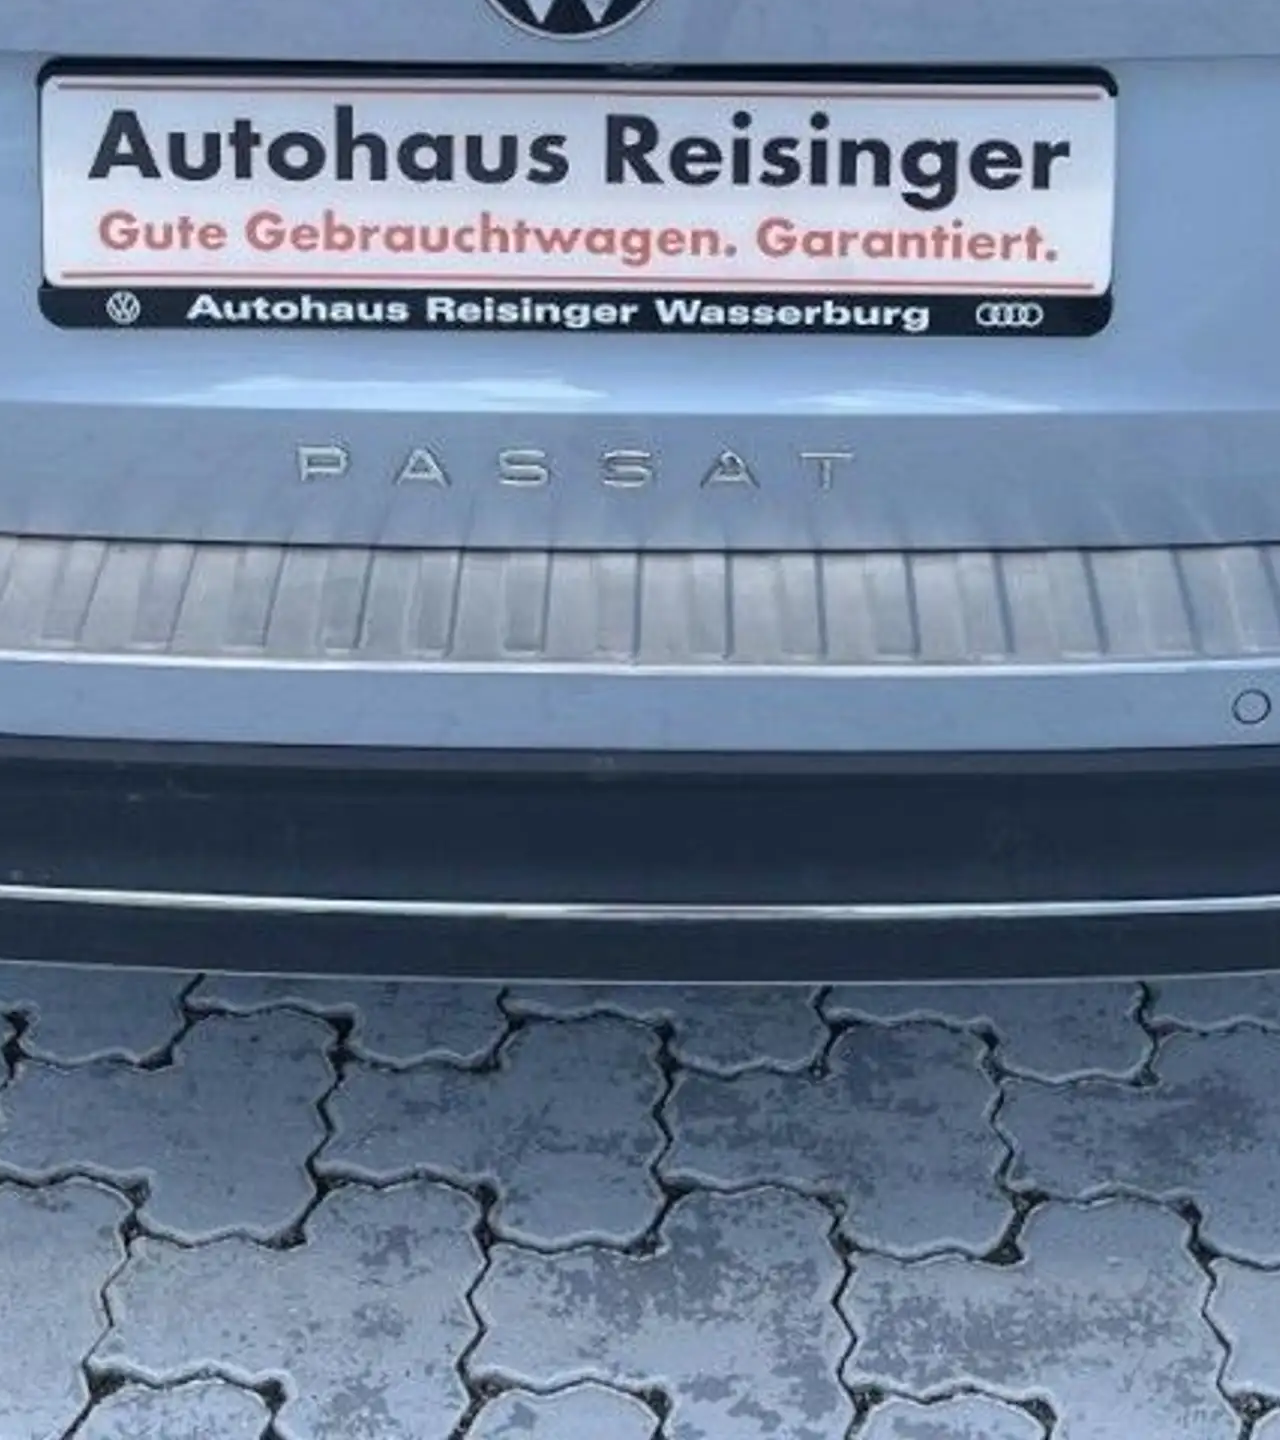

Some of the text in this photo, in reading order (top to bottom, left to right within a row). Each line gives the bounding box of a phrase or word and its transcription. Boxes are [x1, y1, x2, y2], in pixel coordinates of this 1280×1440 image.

[88, 105, 1072, 212] Autohaus Reisinger
[98, 210, 1059, 268] Gute Gebrauchtwagen. Garantiert.
[187, 295, 410, 322] Autohaus
[426, 297, 639, 328] Reisinger
[654, 299, 930, 331] Wasserburg
[297, 446, 854, 489] PASSAT
